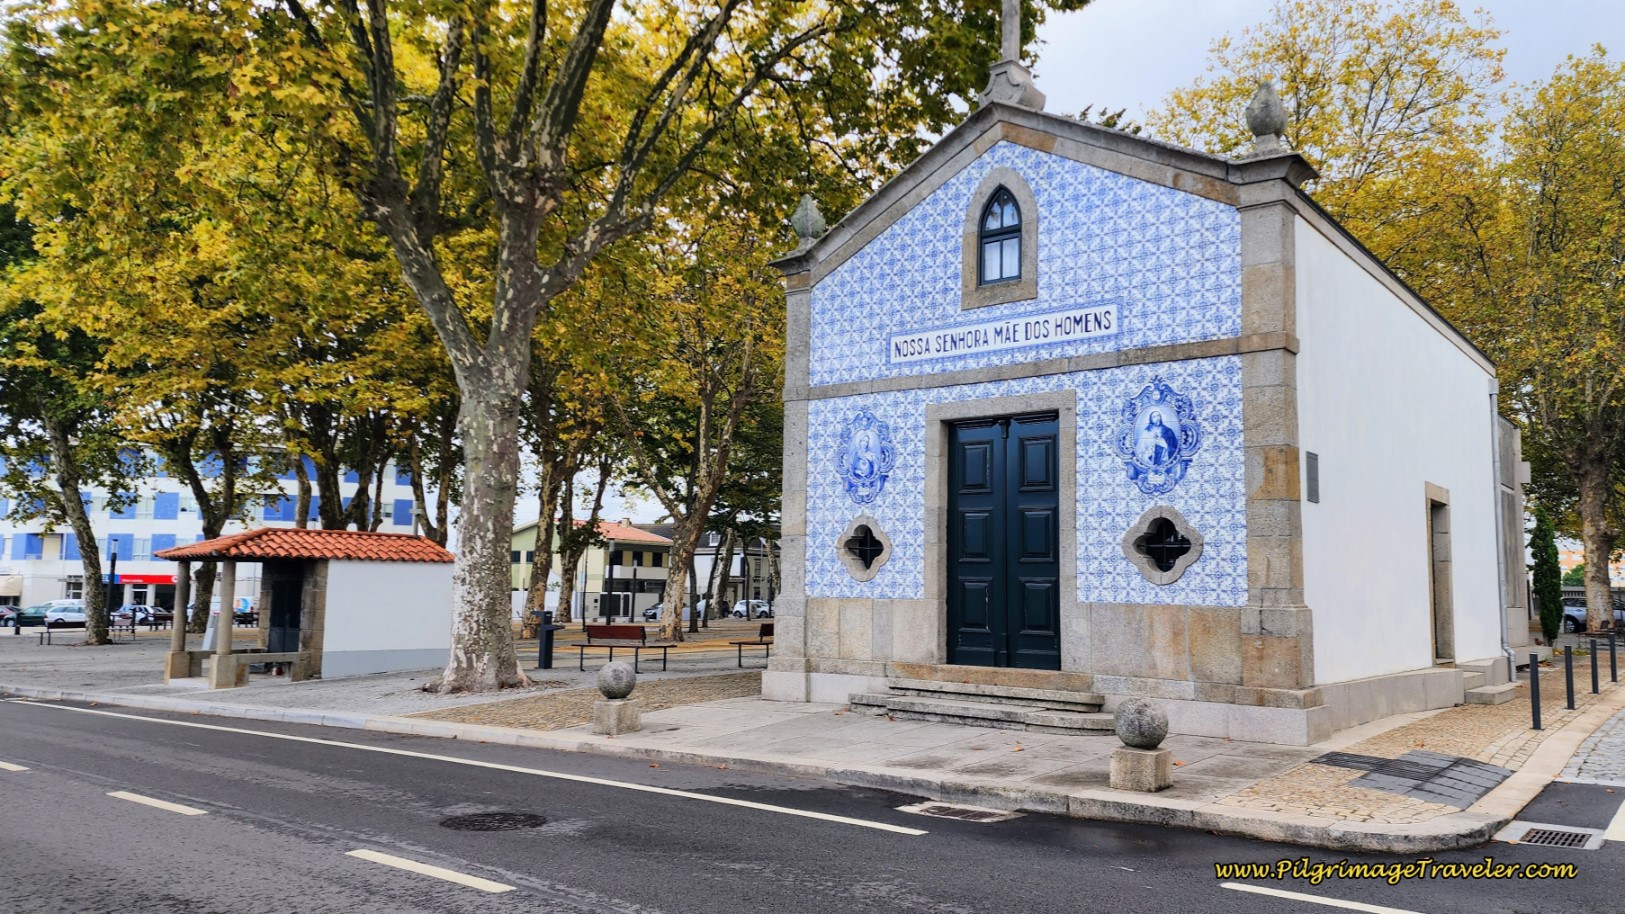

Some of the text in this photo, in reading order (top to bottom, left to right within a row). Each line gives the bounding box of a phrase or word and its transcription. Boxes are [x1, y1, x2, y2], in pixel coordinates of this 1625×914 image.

[894, 310, 1112, 358] NOSSA SENHORA MÃE DOS HOMENS
